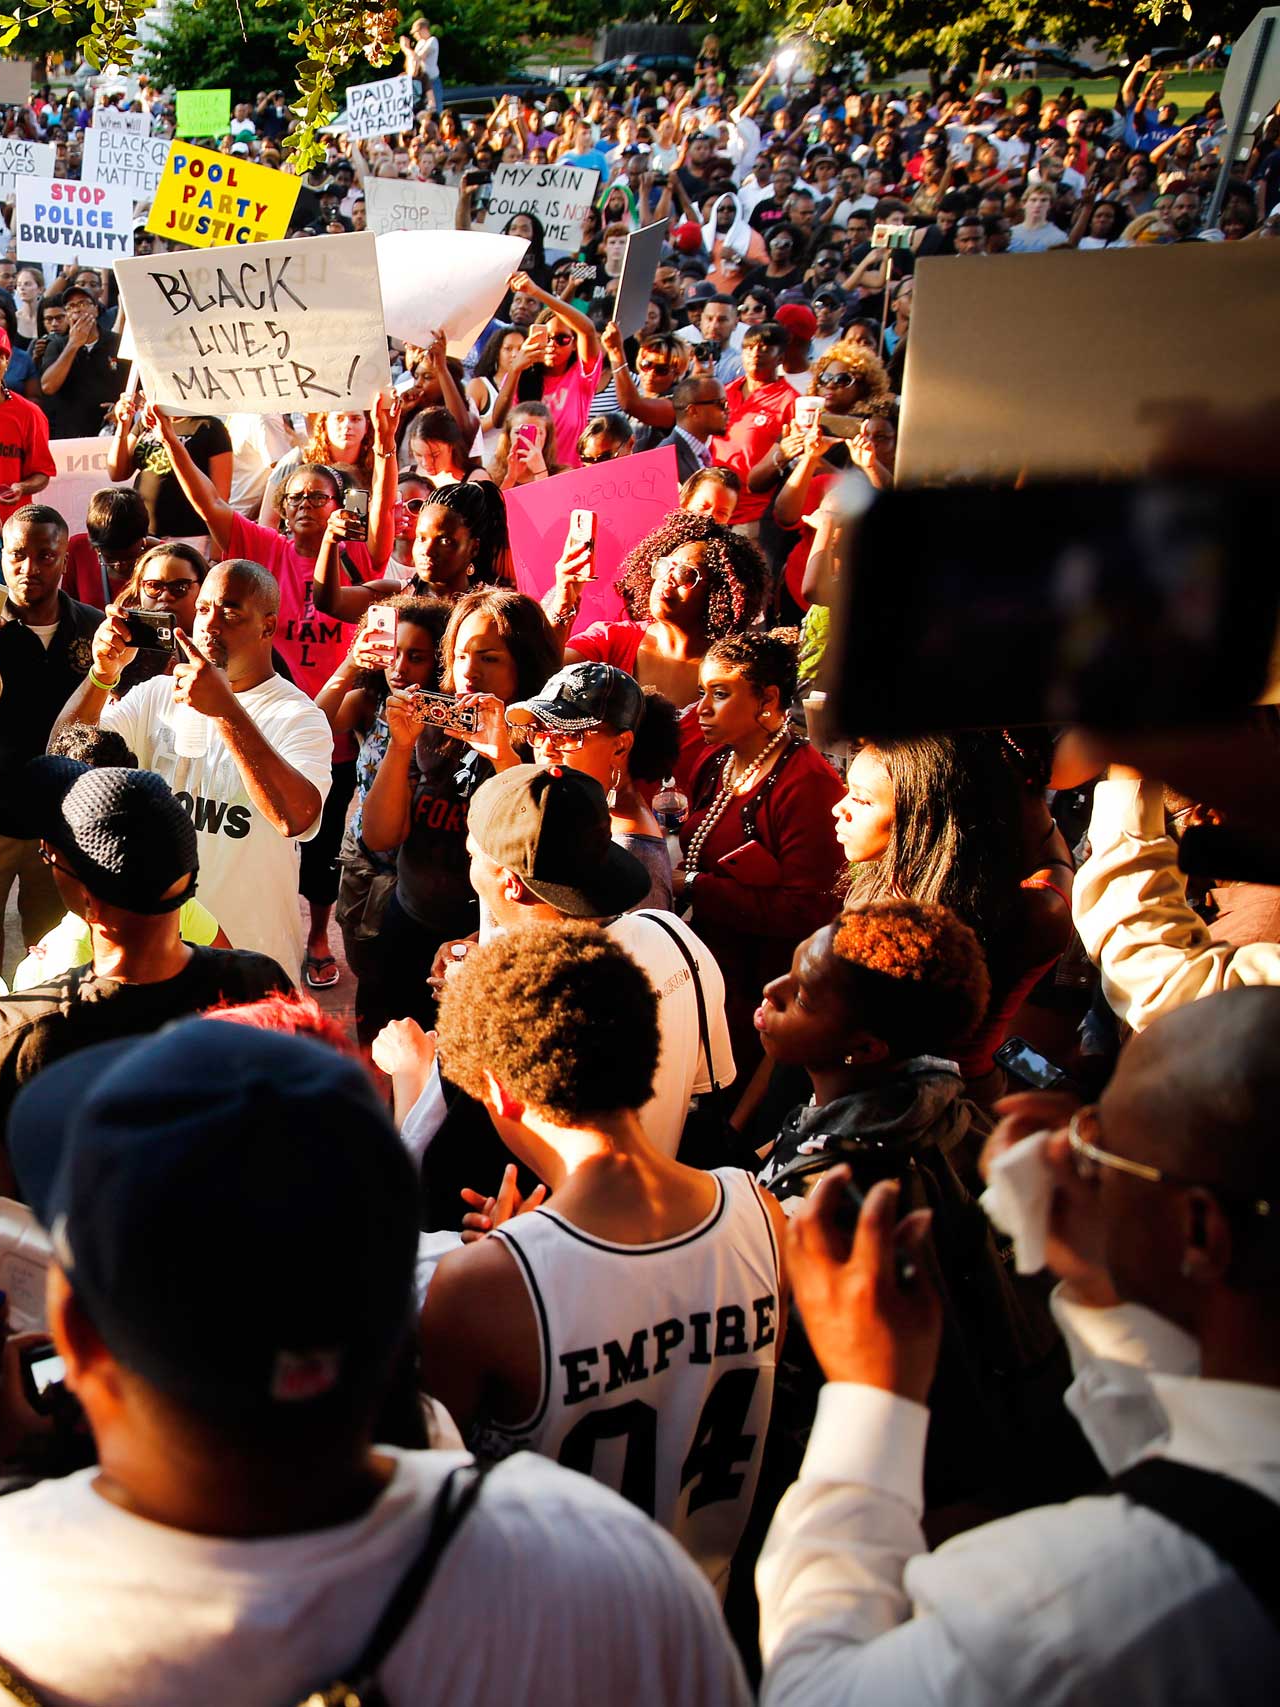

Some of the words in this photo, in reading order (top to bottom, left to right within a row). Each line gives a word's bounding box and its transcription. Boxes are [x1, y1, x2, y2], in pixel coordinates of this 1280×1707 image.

[351, 83, 394, 106] PAID
[99, 131, 150, 153] BLACK
[99, 151, 146, 168] LIVES
[173, 155, 238, 187] POOL
[501, 168, 534, 187] MY
[537, 168, 585, 191] SKIN
[51, 183, 106, 205] STOP
[182, 185, 268, 222] PARTY
[35, 204, 114, 229] POLICE
[391, 204, 430, 221] STOP
[487, 199, 539, 216] COLOR
[546, 201, 560, 217] IS
[20, 223, 128, 251] BRUTALITY
[147, 256, 308, 316] BLACK
[190, 321, 291, 360] LIVES
[299, 622, 342, 643] AM
[558, 1295, 775, 1406] EMPIRE
